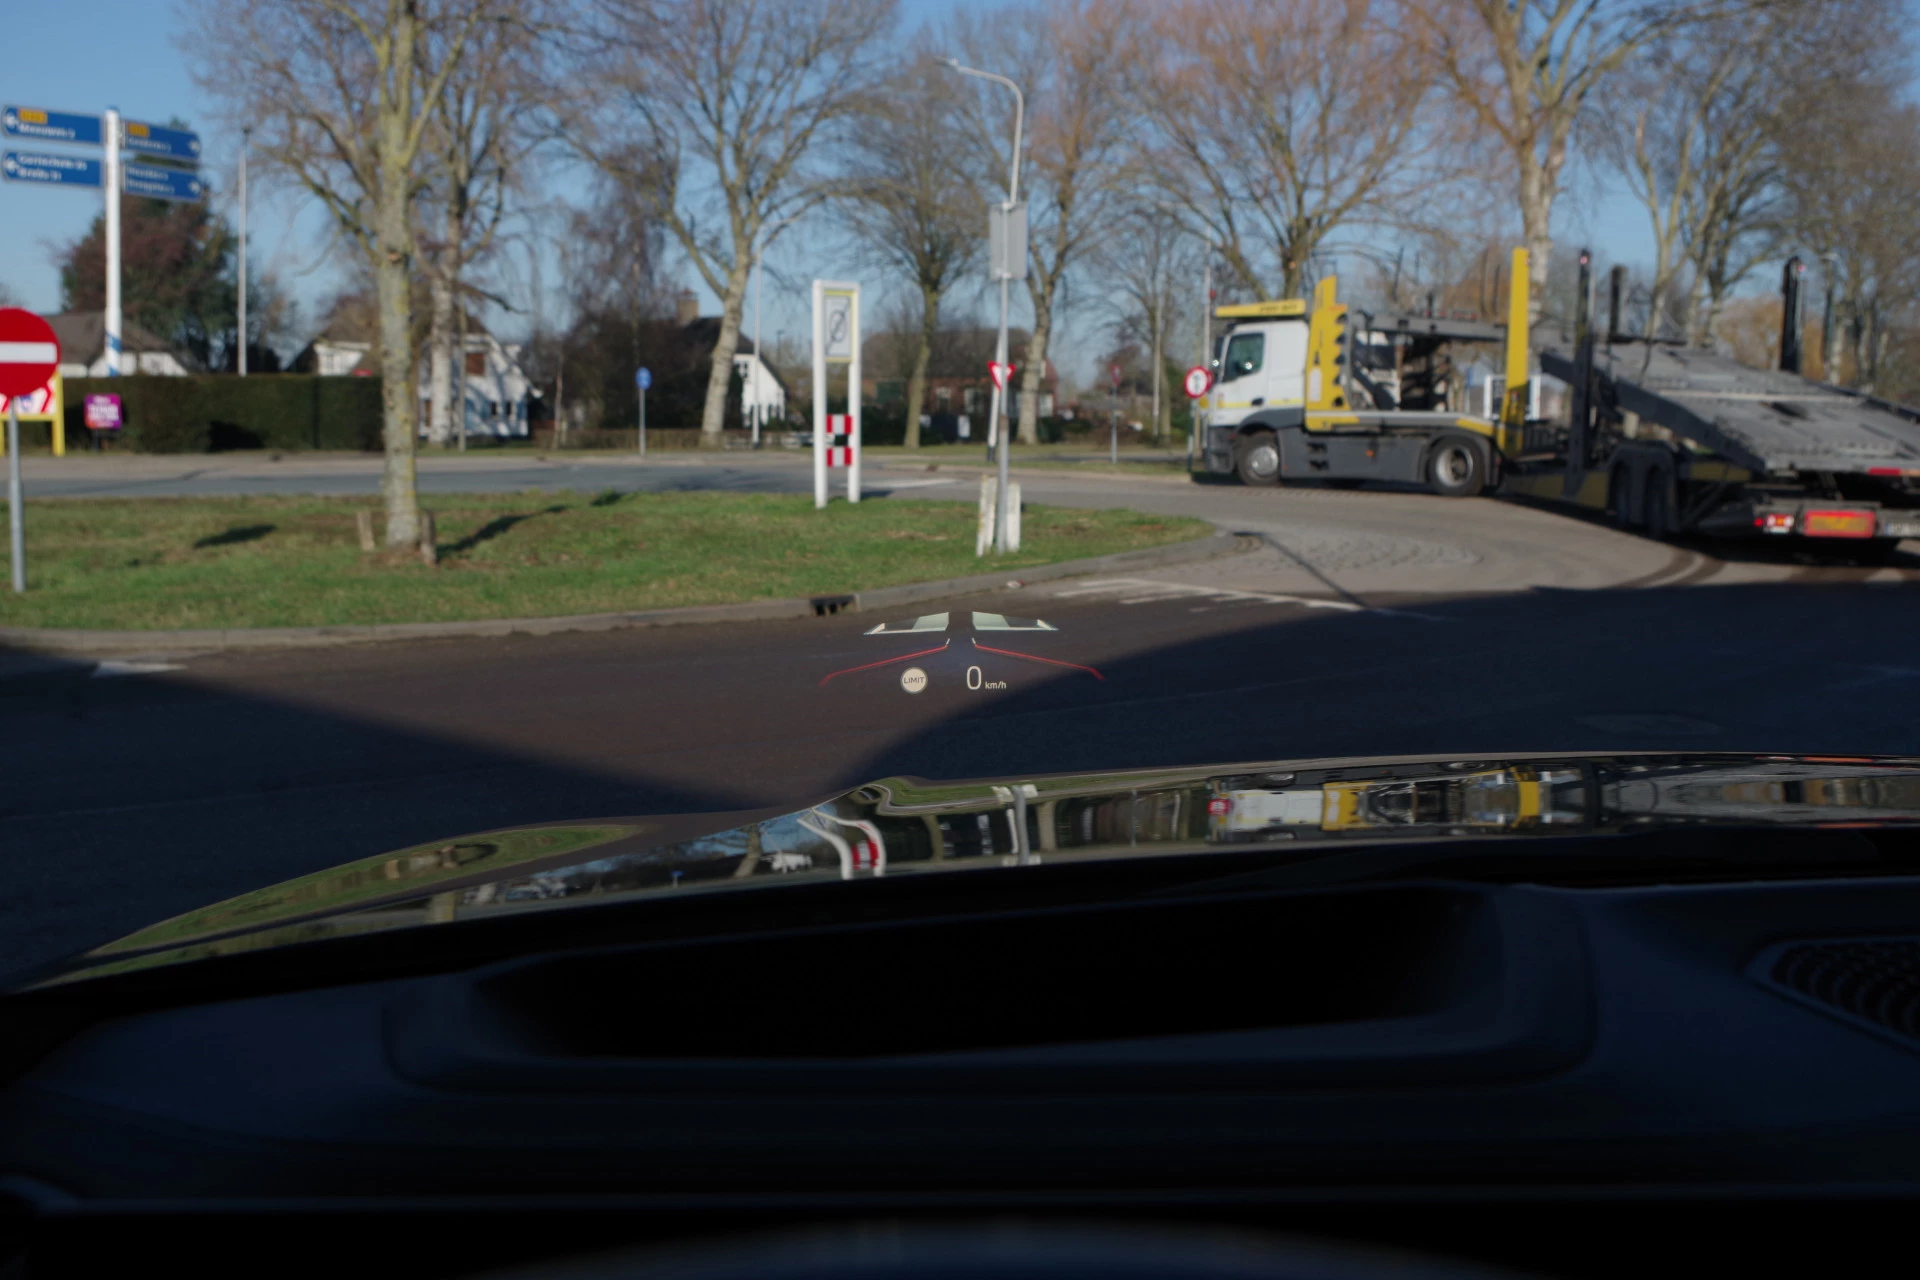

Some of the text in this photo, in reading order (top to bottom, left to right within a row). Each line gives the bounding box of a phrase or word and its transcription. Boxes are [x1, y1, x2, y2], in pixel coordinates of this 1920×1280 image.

[903, 676, 925, 684] LIMIT
[966, 665, 1007, 690] 0 km/h
